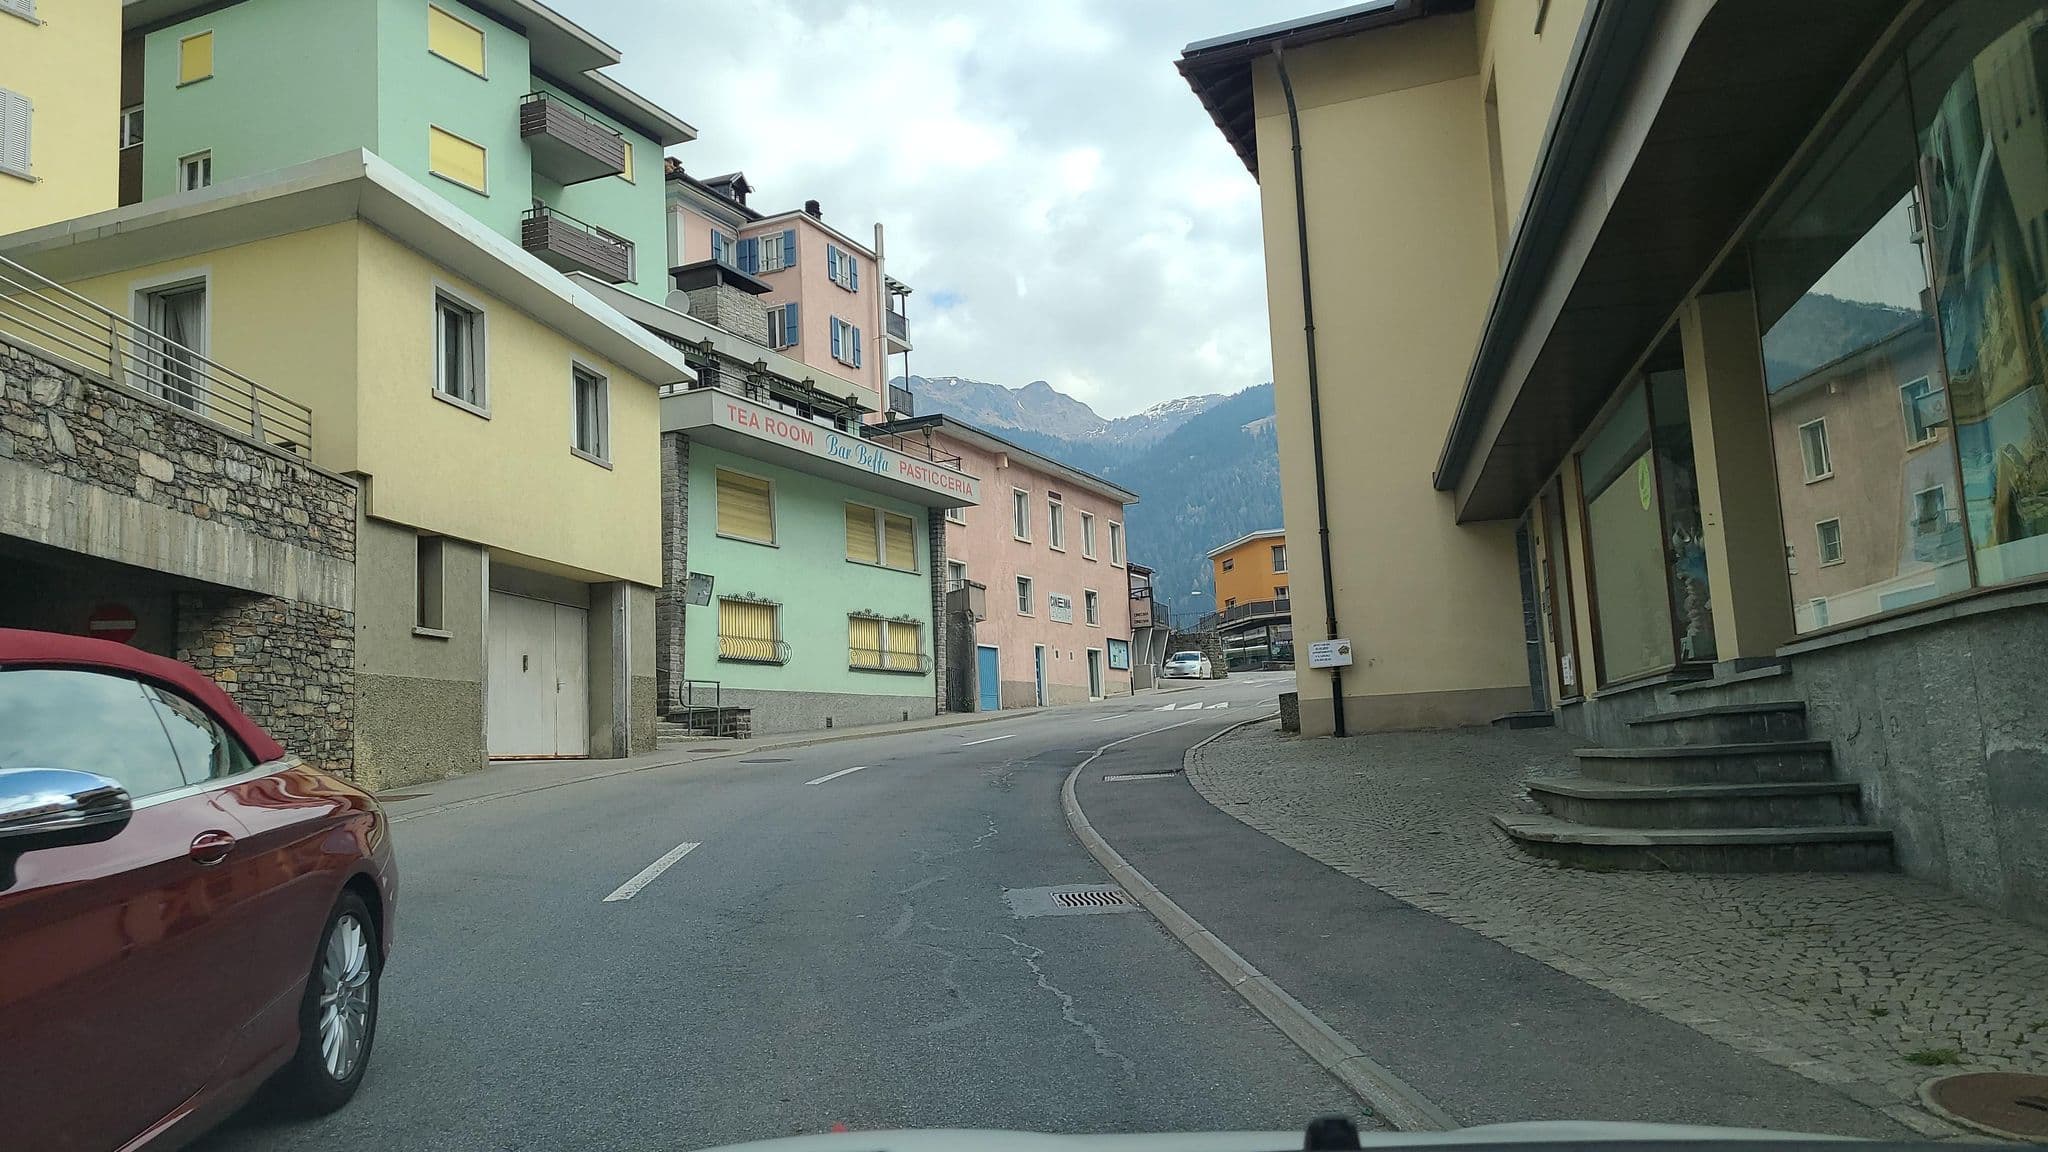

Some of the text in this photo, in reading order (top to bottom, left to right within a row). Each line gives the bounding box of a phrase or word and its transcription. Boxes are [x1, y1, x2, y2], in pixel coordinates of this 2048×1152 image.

[727, 404, 973, 497] TEA ROOM Bar Beffa PASTICCERIA
